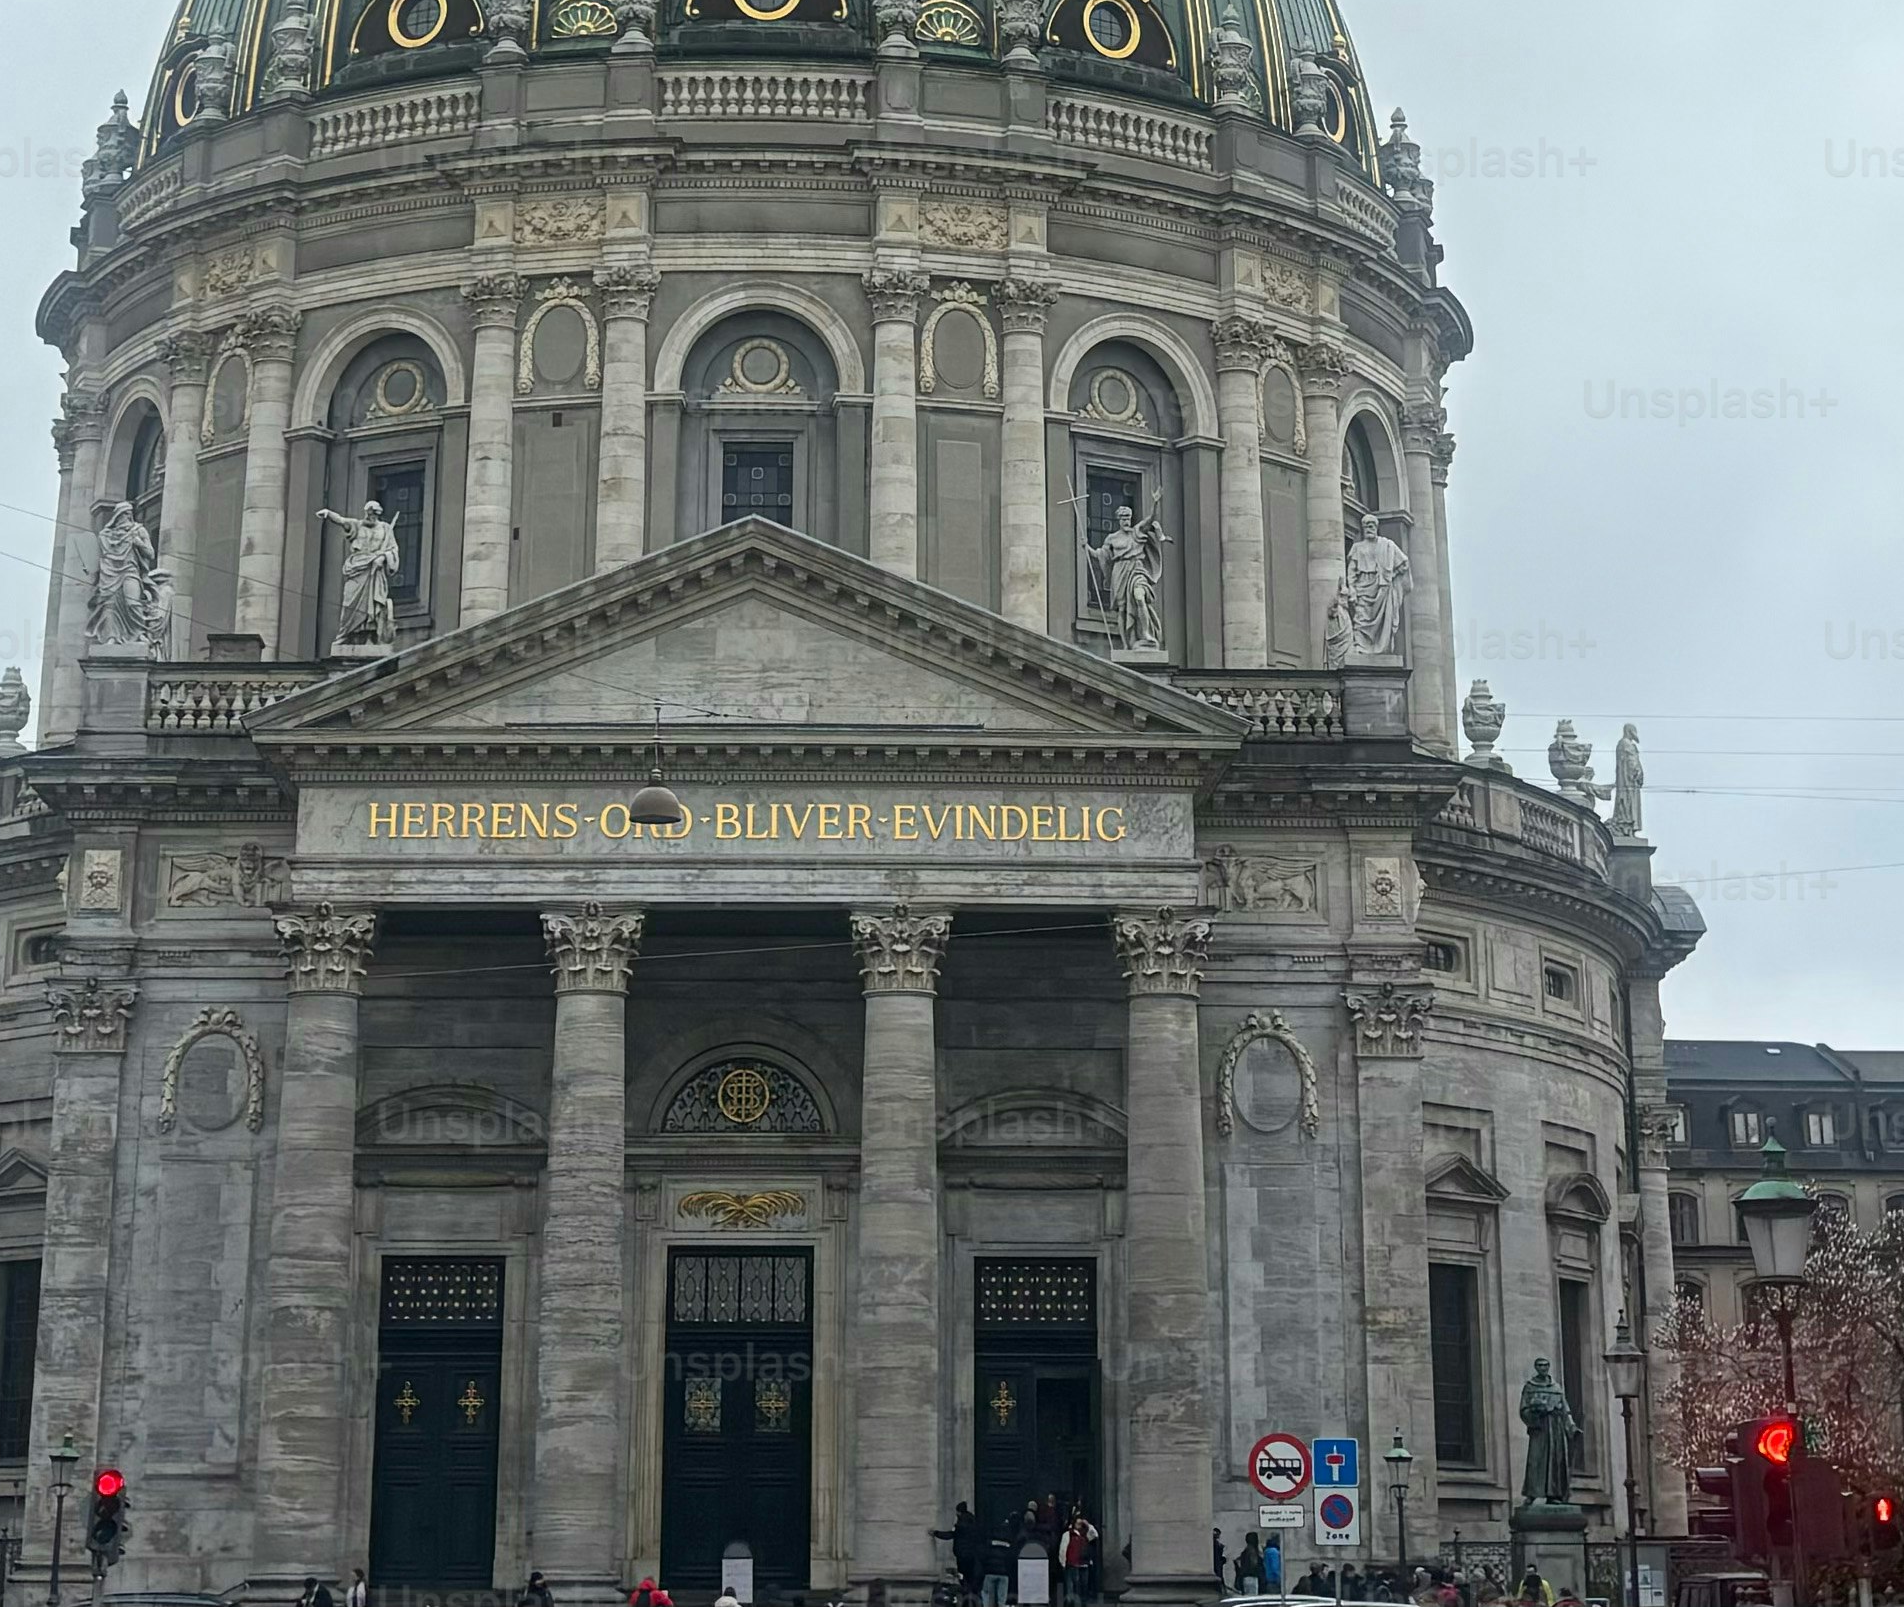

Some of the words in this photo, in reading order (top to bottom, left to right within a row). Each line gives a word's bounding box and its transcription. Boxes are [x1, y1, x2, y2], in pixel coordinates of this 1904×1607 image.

[369, 802, 578, 839] HERRENS
[715, 803, 872, 840] BLIVER
[893, 804, 1127, 842] EVINDELIG
[1325, 1531, 1350, 1540] Zone
